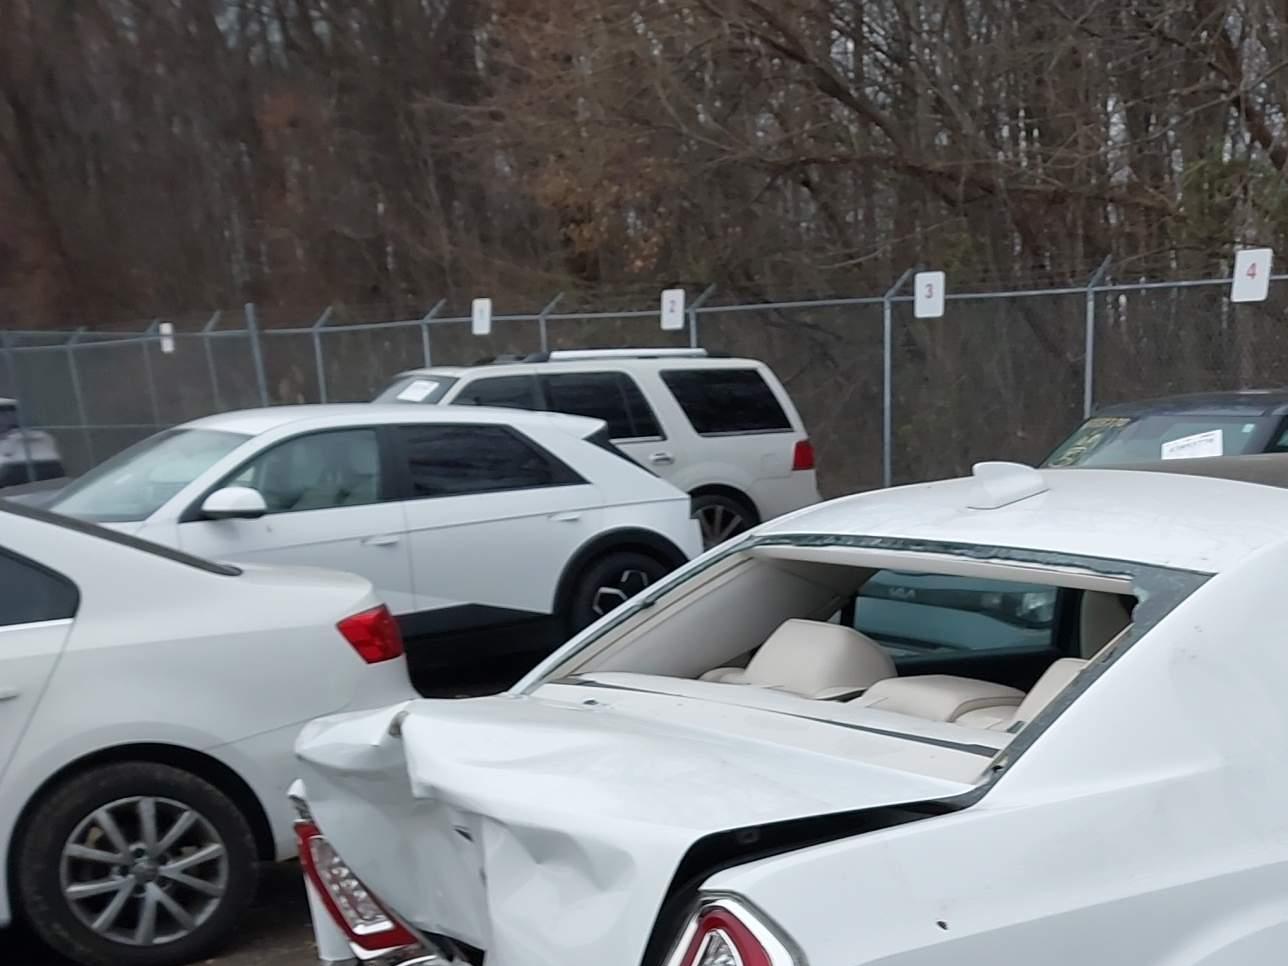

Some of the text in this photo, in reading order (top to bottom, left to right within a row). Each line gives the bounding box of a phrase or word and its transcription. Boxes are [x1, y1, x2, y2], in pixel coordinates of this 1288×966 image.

[1245, 262, 1257, 279] 4
[924, 283, 934, 299] 3
[667, 299, 677, 313] 2
